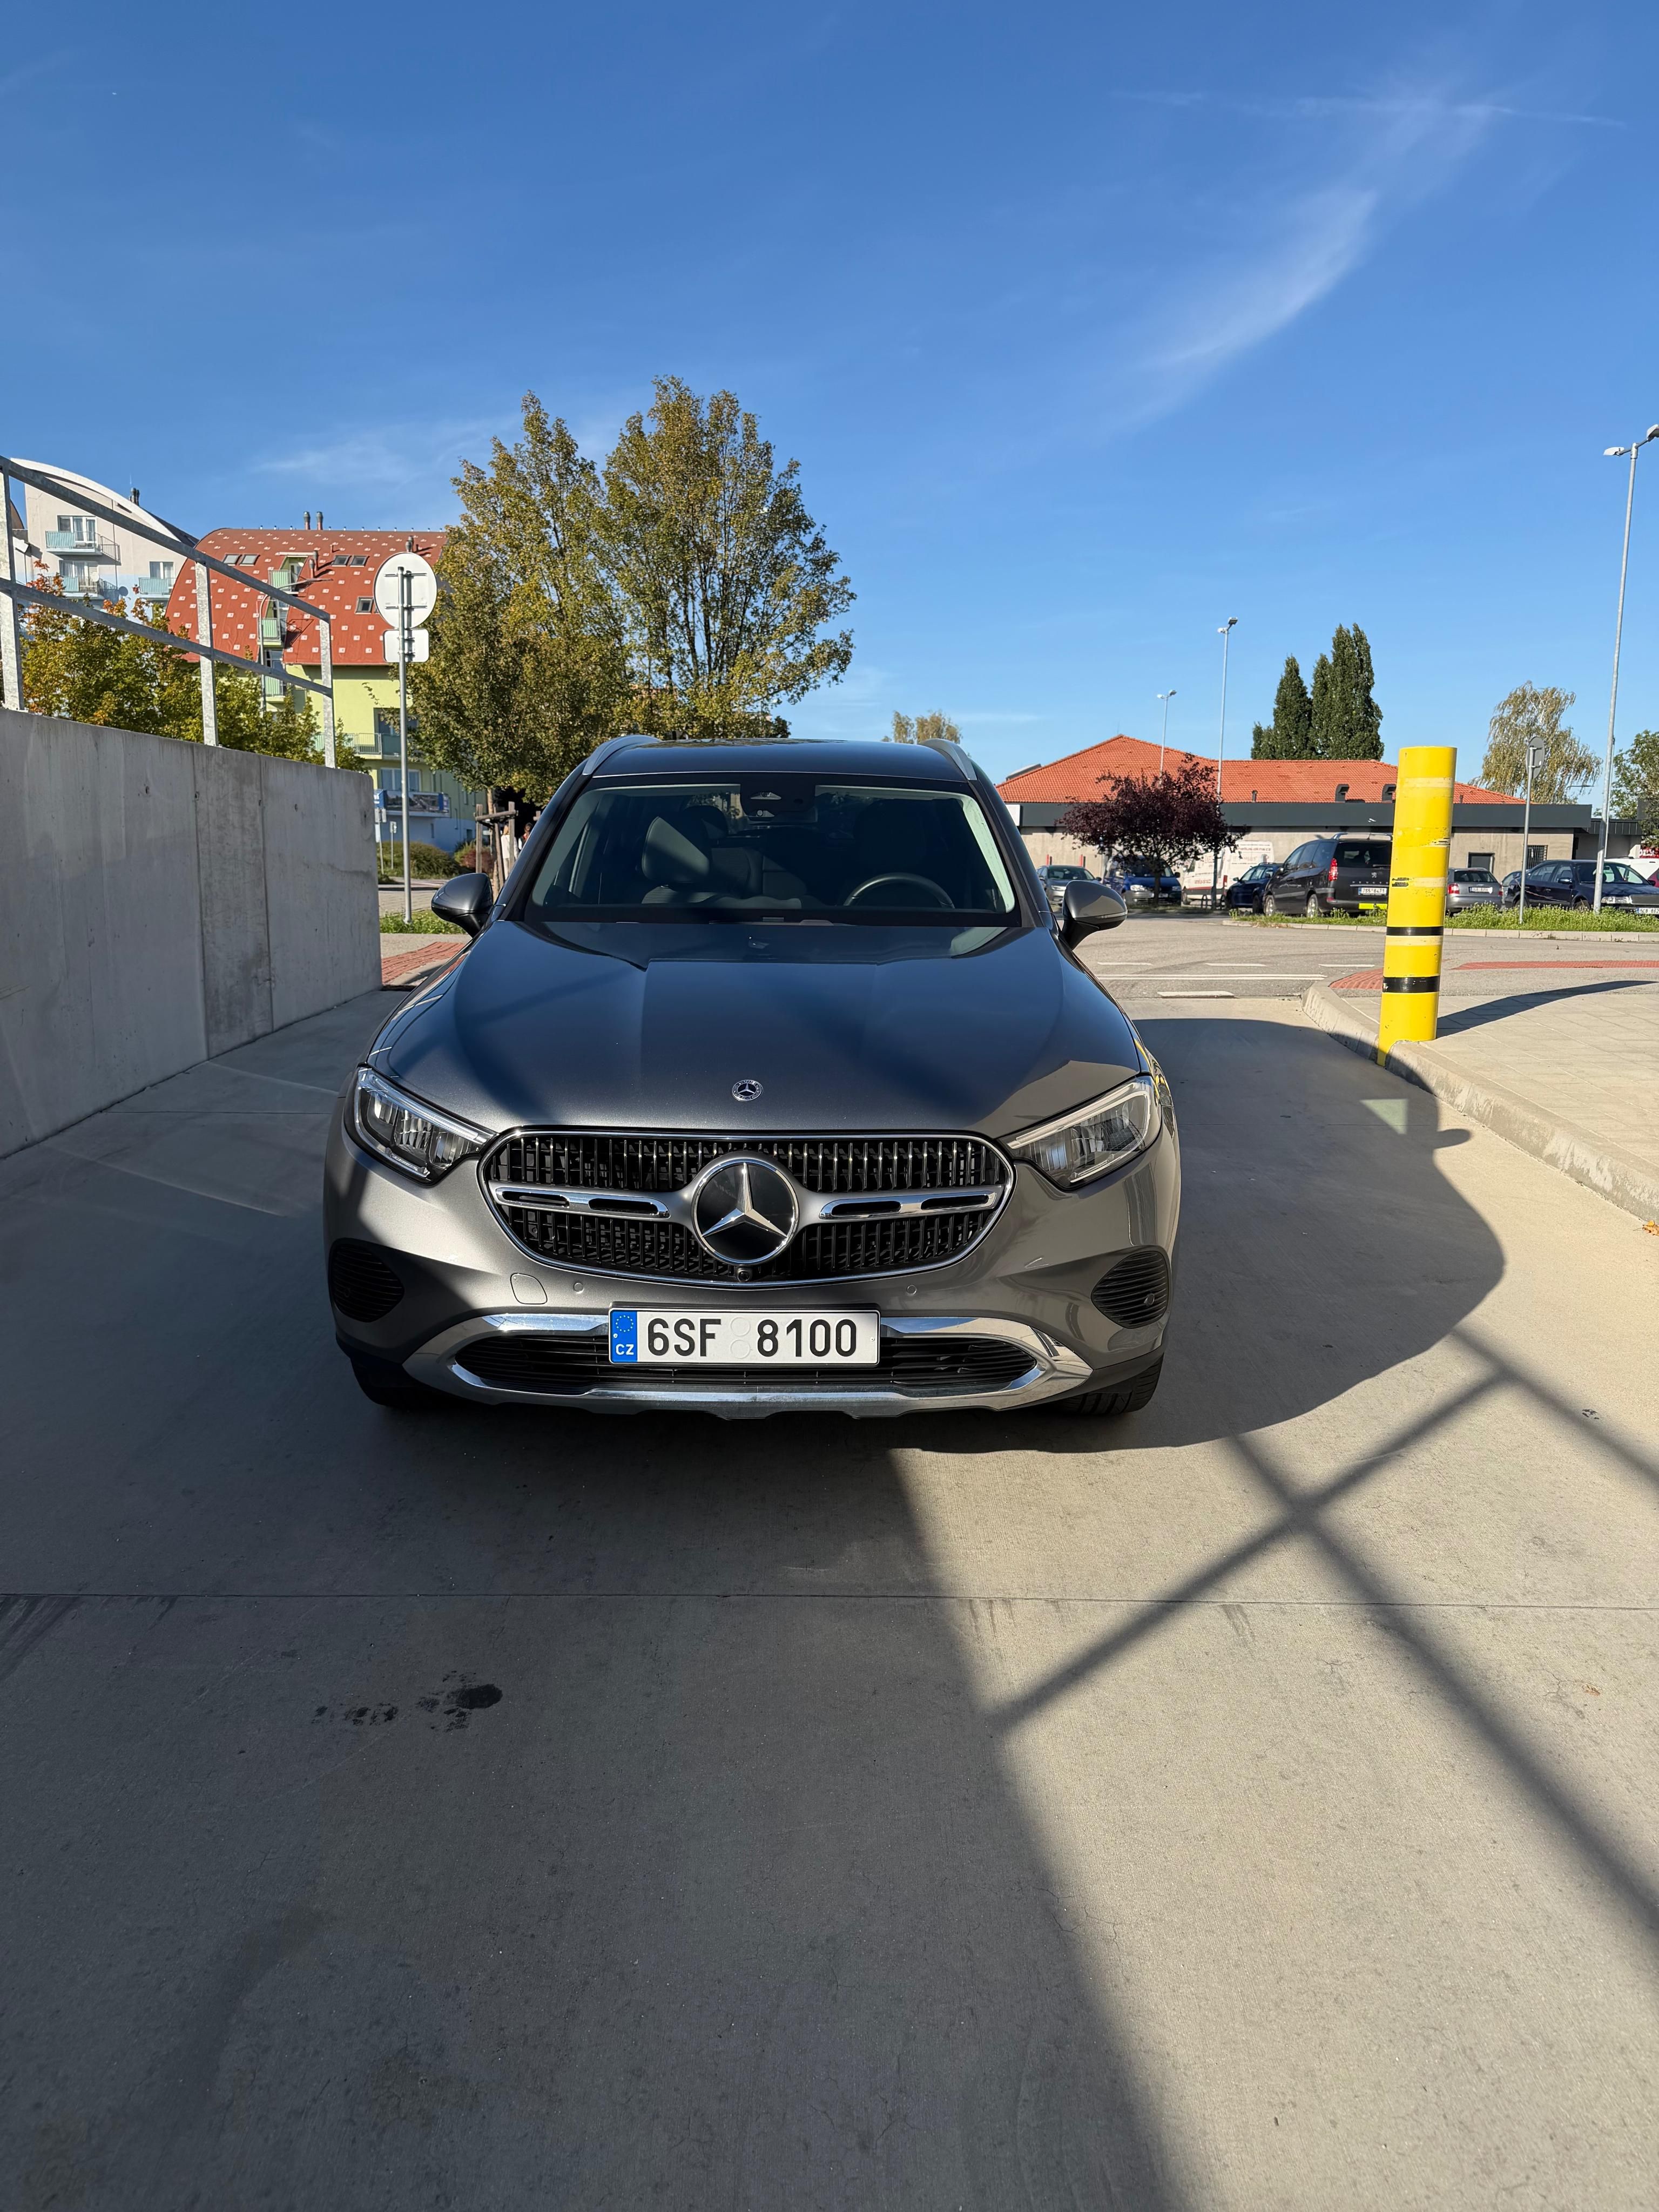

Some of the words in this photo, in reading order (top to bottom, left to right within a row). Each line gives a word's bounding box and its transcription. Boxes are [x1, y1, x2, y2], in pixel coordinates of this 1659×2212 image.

[616, 1344, 634, 1355] CZ
[648, 1318, 721, 1357] 6SF
[757, 1319, 857, 1357] 8100
